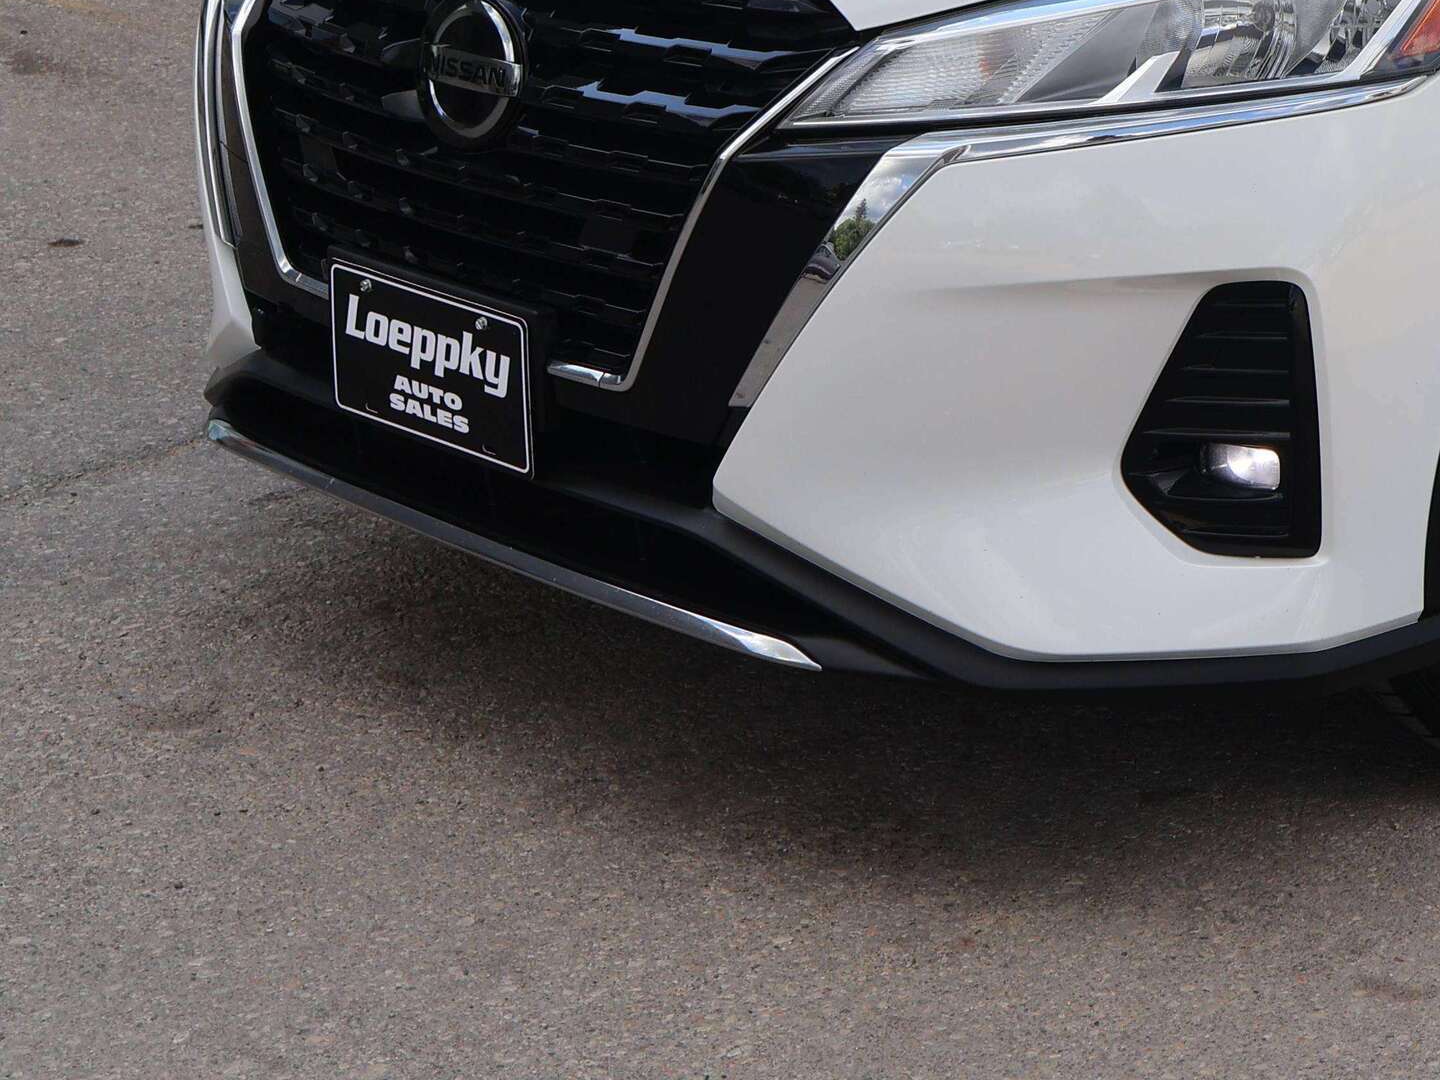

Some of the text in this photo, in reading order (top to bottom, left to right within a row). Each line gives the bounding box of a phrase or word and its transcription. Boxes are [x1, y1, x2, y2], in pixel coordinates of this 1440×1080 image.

[428, 50, 505, 89] NISSAN
[345, 293, 511, 399] Loeppky
[393, 374, 463, 411] AUTO
[389, 392, 470, 434] SALES
